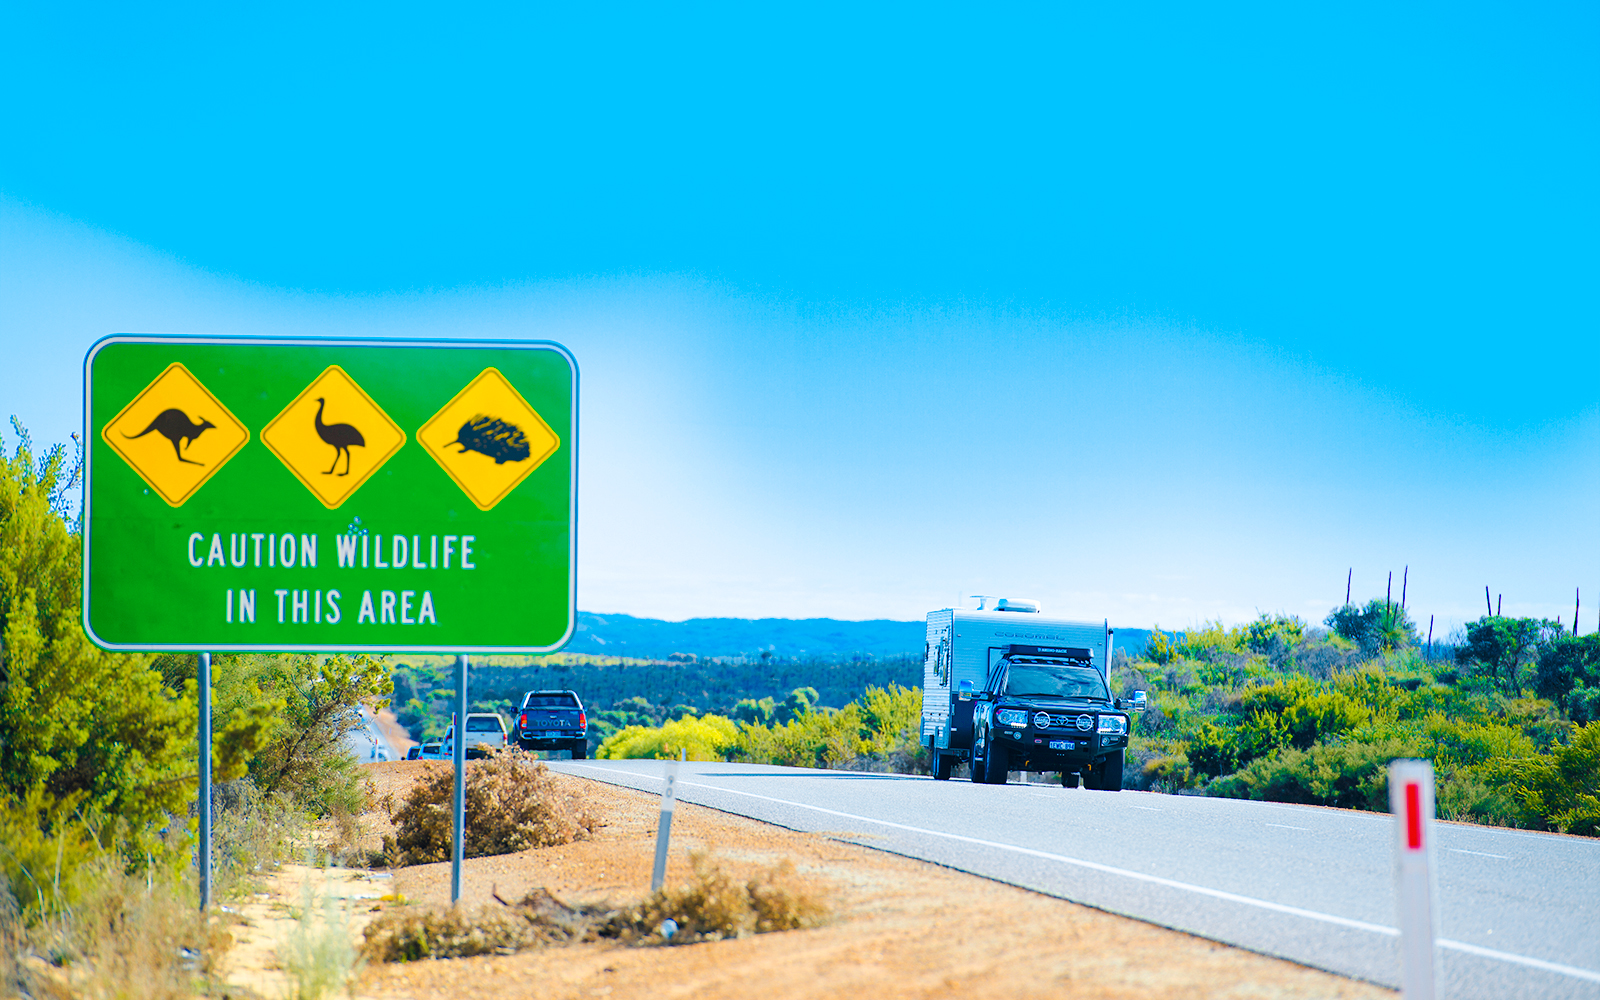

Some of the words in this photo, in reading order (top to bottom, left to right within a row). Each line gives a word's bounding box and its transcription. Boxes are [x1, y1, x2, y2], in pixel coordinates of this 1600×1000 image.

[188, 532, 318, 568] CAUTION
[335, 534, 477, 569] WILDLIFE
[226, 589, 256, 624] IN
[274, 589, 342, 625] THIS
[357, 590, 437, 625] AREA
